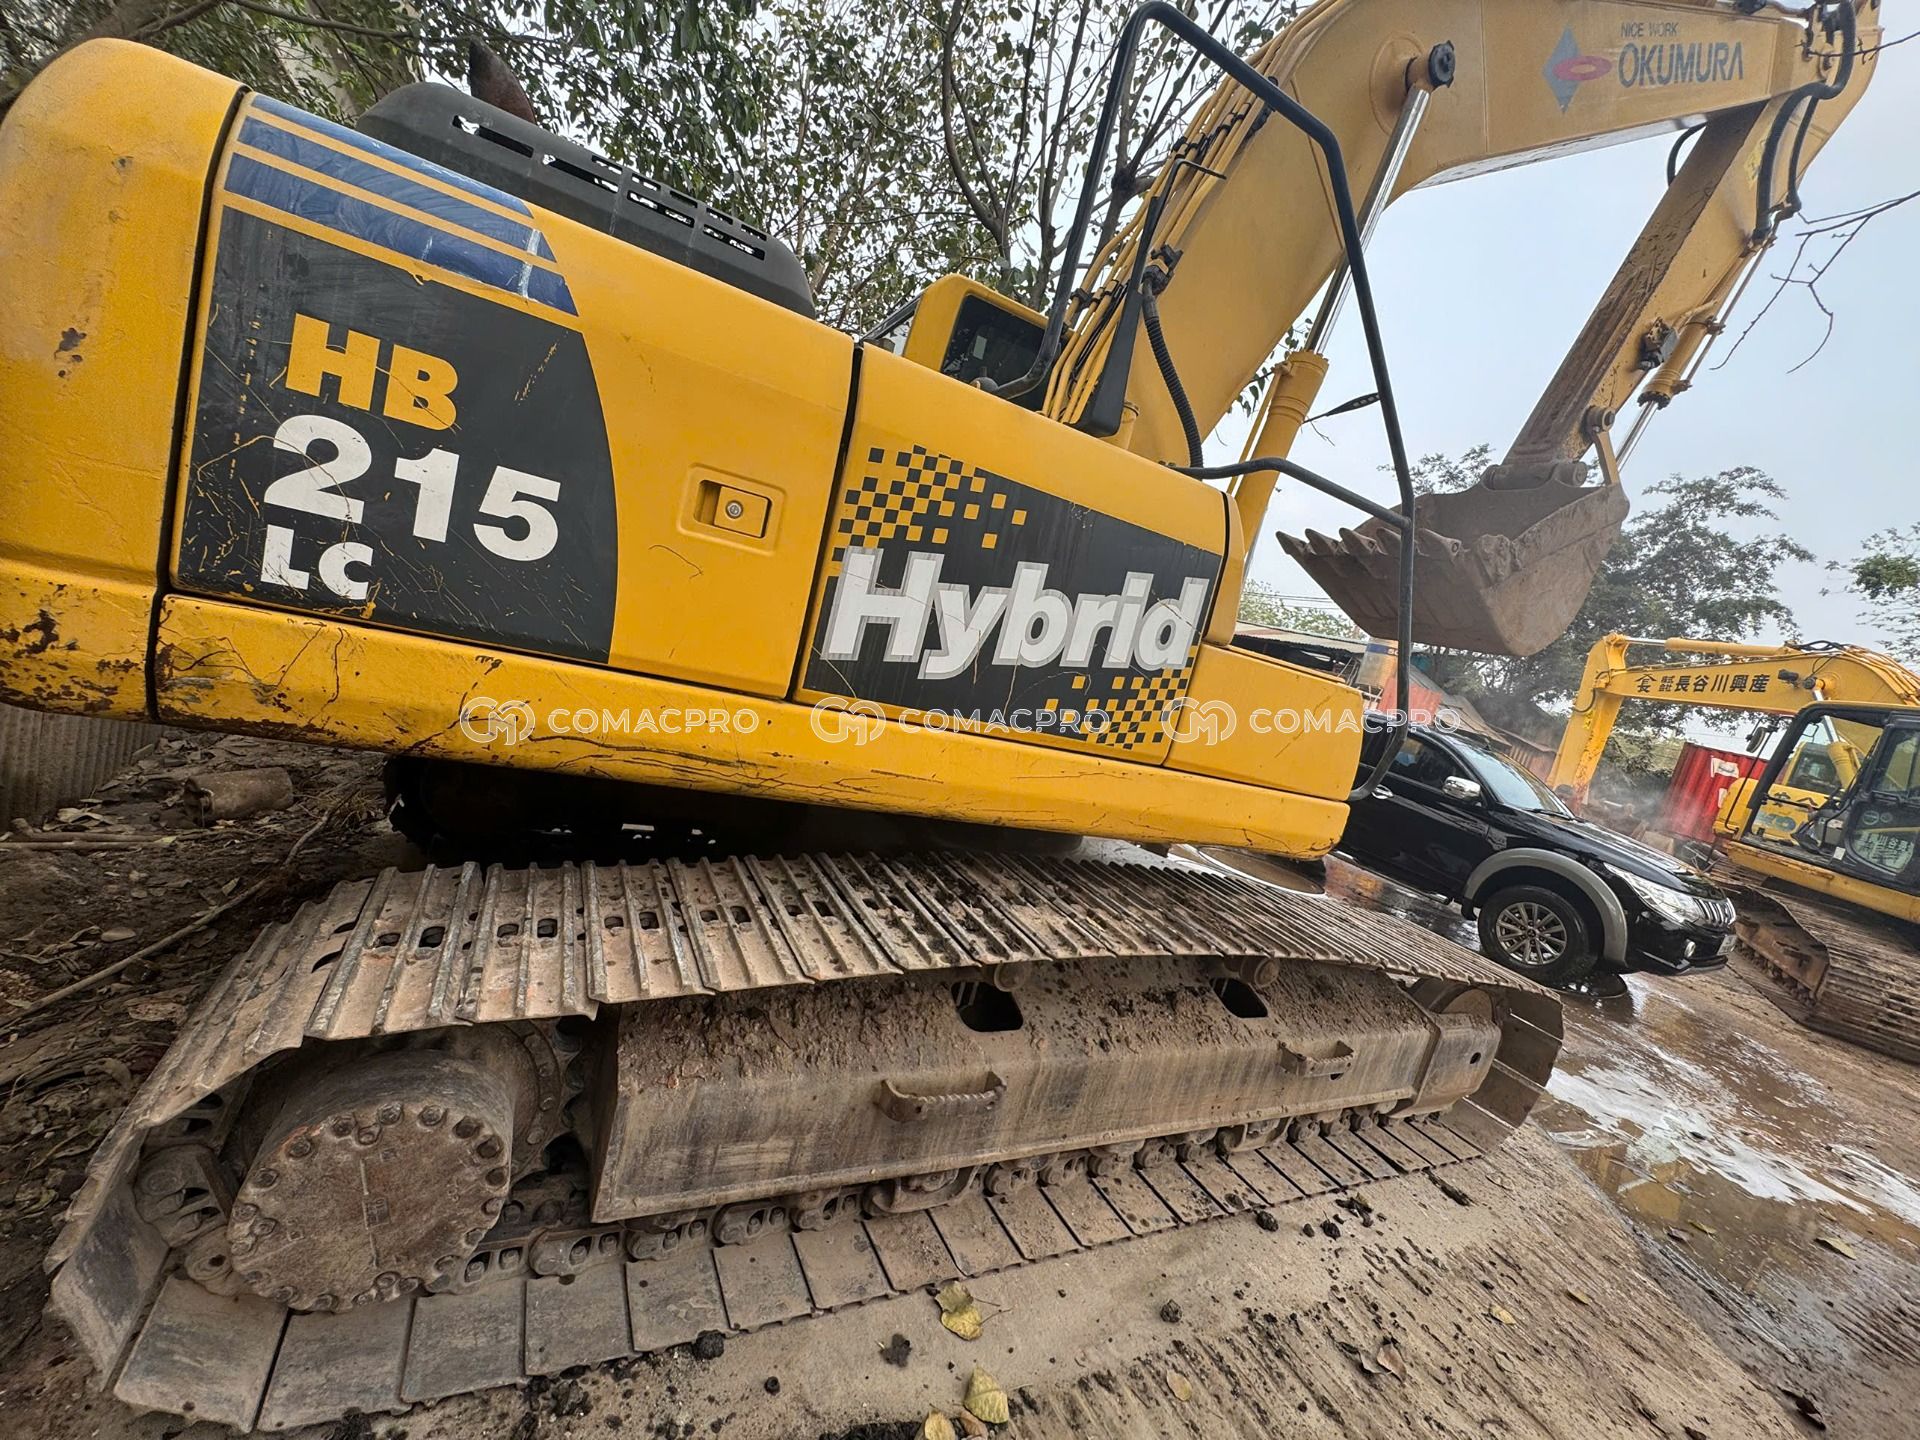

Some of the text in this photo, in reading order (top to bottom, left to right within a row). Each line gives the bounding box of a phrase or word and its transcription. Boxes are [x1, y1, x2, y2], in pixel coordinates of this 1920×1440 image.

[1618, 41, 1744, 88] OKUMURA
[1621, 22, 1644, 37] NICE
[285, 313, 459, 431] HB
[263, 414, 562, 562] 215
[260, 524, 374, 600] LC
[820, 546, 1210, 680] Hybrid
